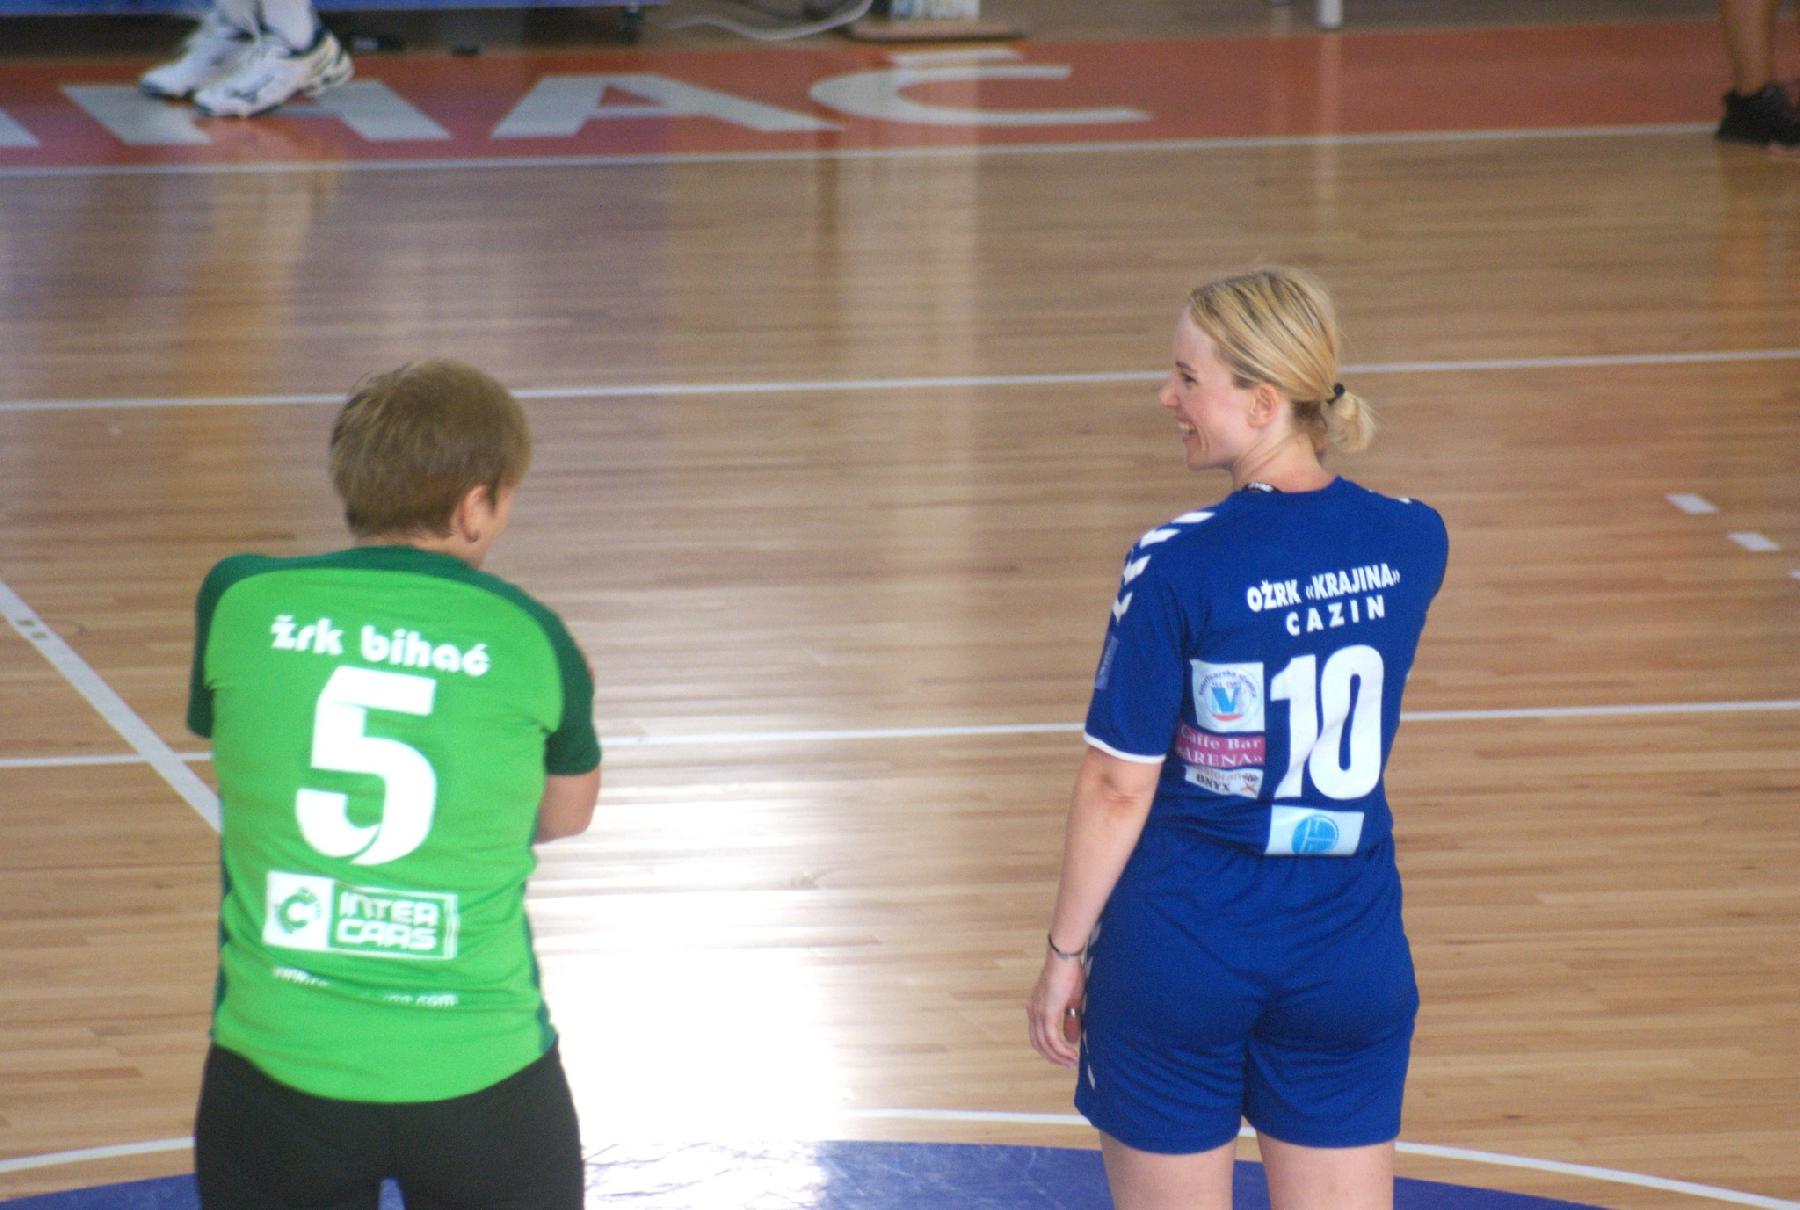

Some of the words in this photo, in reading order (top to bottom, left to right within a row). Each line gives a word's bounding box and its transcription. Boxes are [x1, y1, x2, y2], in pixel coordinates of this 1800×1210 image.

[1247, 579, 1301, 612] OŽRK
[1286, 594, 1385, 636] CAZIN
[271, 614, 343, 656] žrk
[361, 624, 491, 677] bihać
[1270, 645, 1384, 800] 10
[296, 665, 437, 866] 5
[338, 891, 440, 928] INTER
[335, 918, 438, 950] CARS
